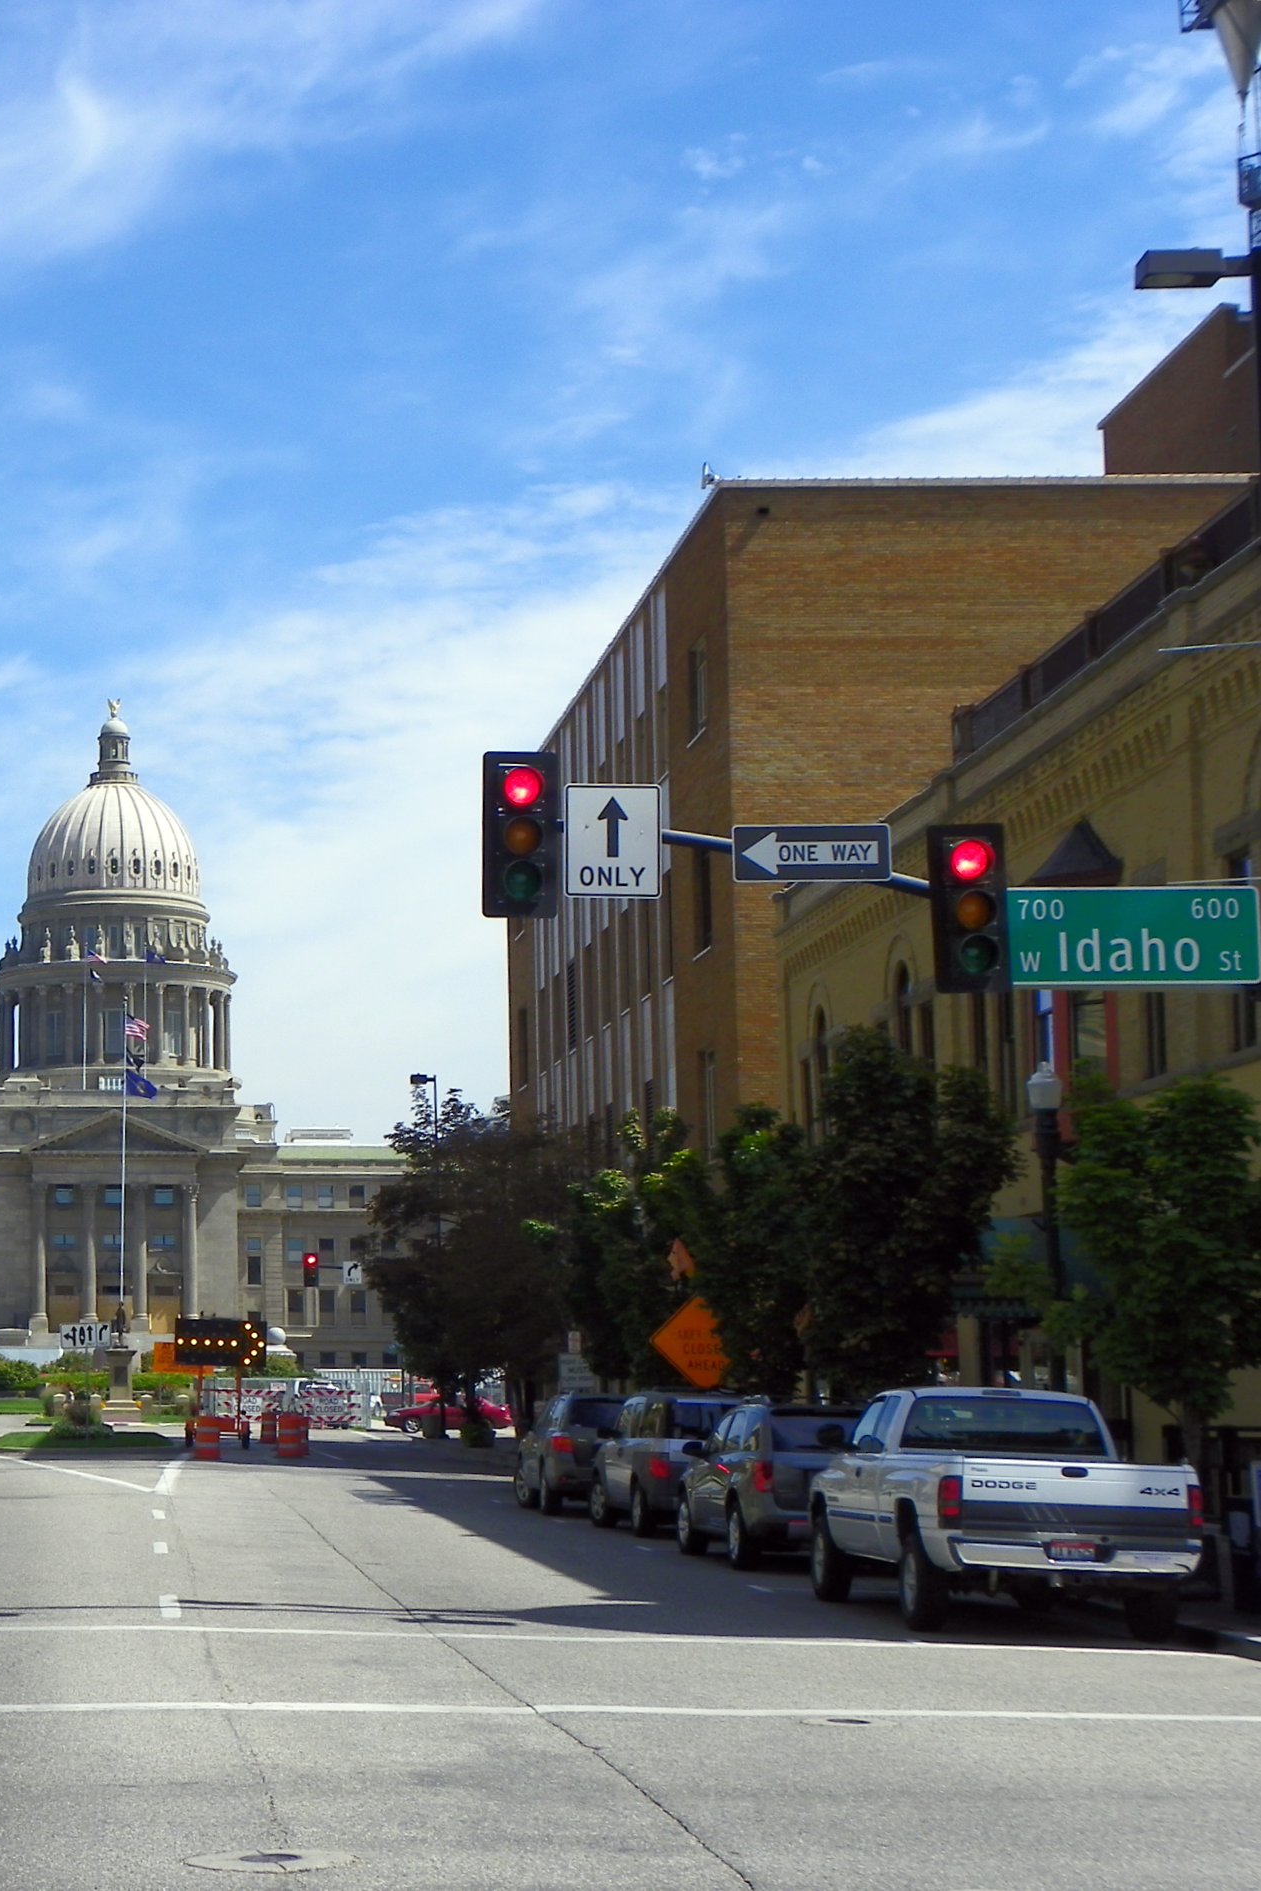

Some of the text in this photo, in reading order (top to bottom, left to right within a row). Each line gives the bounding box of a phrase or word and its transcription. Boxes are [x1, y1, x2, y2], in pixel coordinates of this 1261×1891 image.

[778, 843, 872, 863] ONE WAY
[579, 865, 646, 888] ONLY
[1017, 899, 1065, 921] 700
[1190, 898, 1240, 919] 600
[1019, 927, 1243, 973] W Idaho St
[683, 1343, 720, 1355] CLOSE
[687, 1359, 725, 1371] AHEAD
[318, 1397, 339, 1405] ROAD
[234, 1405, 261, 1413] COSED
[315, 1405, 345, 1414] CLOSED
[971, 1479, 1037, 1491] DODGE
[1139, 1486, 1181, 1497] 4x4
